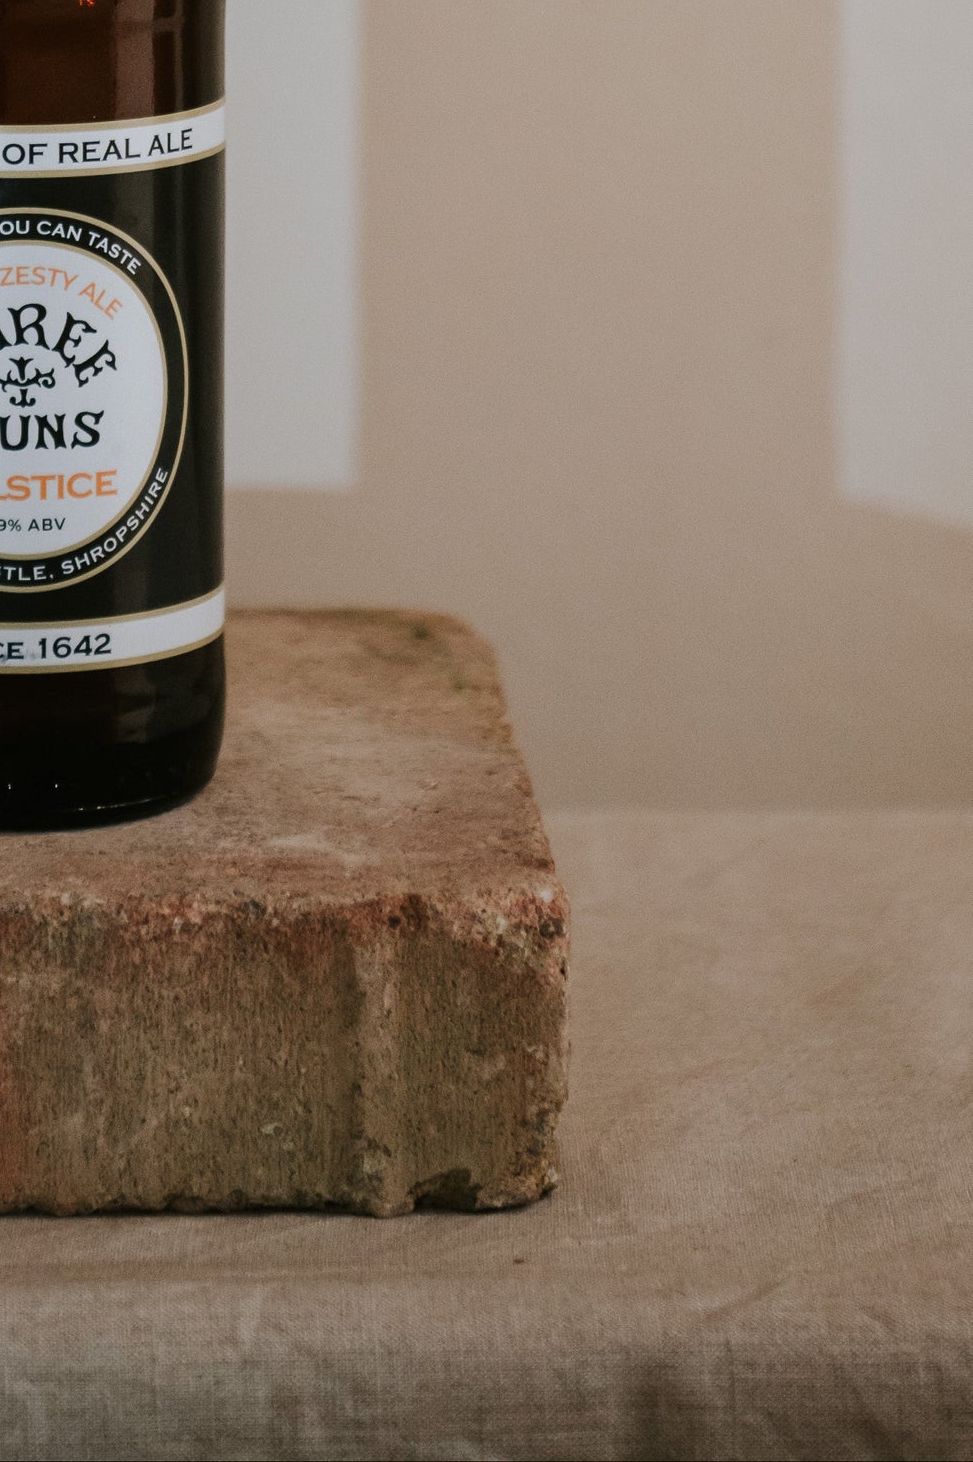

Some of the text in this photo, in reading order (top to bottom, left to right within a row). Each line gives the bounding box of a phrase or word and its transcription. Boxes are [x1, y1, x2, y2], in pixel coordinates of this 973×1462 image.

[1, 143, 48, 165] OF
[58, 138, 140, 164] REAL
[148, 128, 193, 156] ALE
[36, 220, 83, 242] CAN
[88, 231, 142, 275] TASTE
[0, 266, 79, 291] ZESTY
[78, 283, 124, 320] ALE
[27, 517, 66, 532] ABV
[61, 467, 169, 576] SHROPSHIRE
[38, 633, 112, 660] 1642
